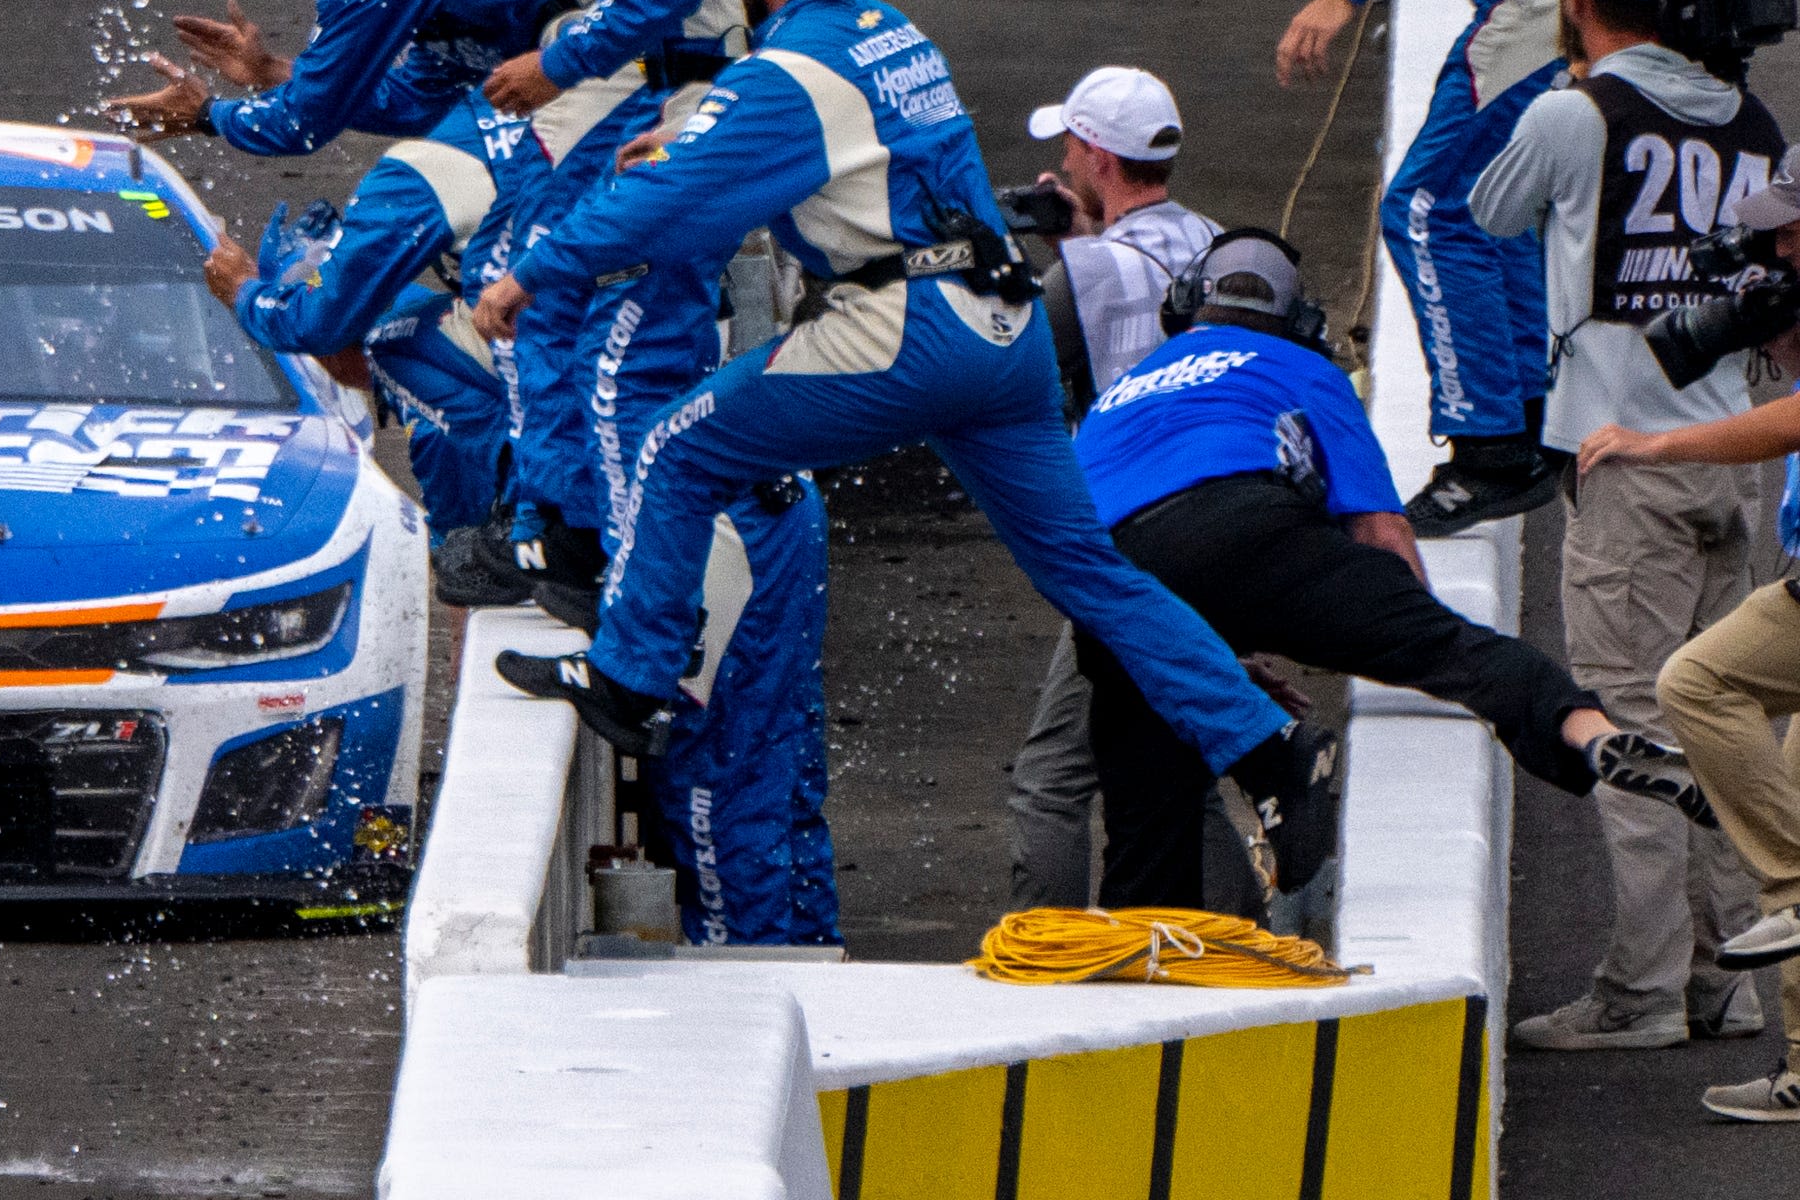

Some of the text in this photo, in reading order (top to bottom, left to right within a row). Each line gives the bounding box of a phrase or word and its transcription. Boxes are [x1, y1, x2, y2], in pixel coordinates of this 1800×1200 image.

[515, 539, 548, 570] N
[559, 659, 592, 689] N
[45, 720, 139, 743] ZL1
